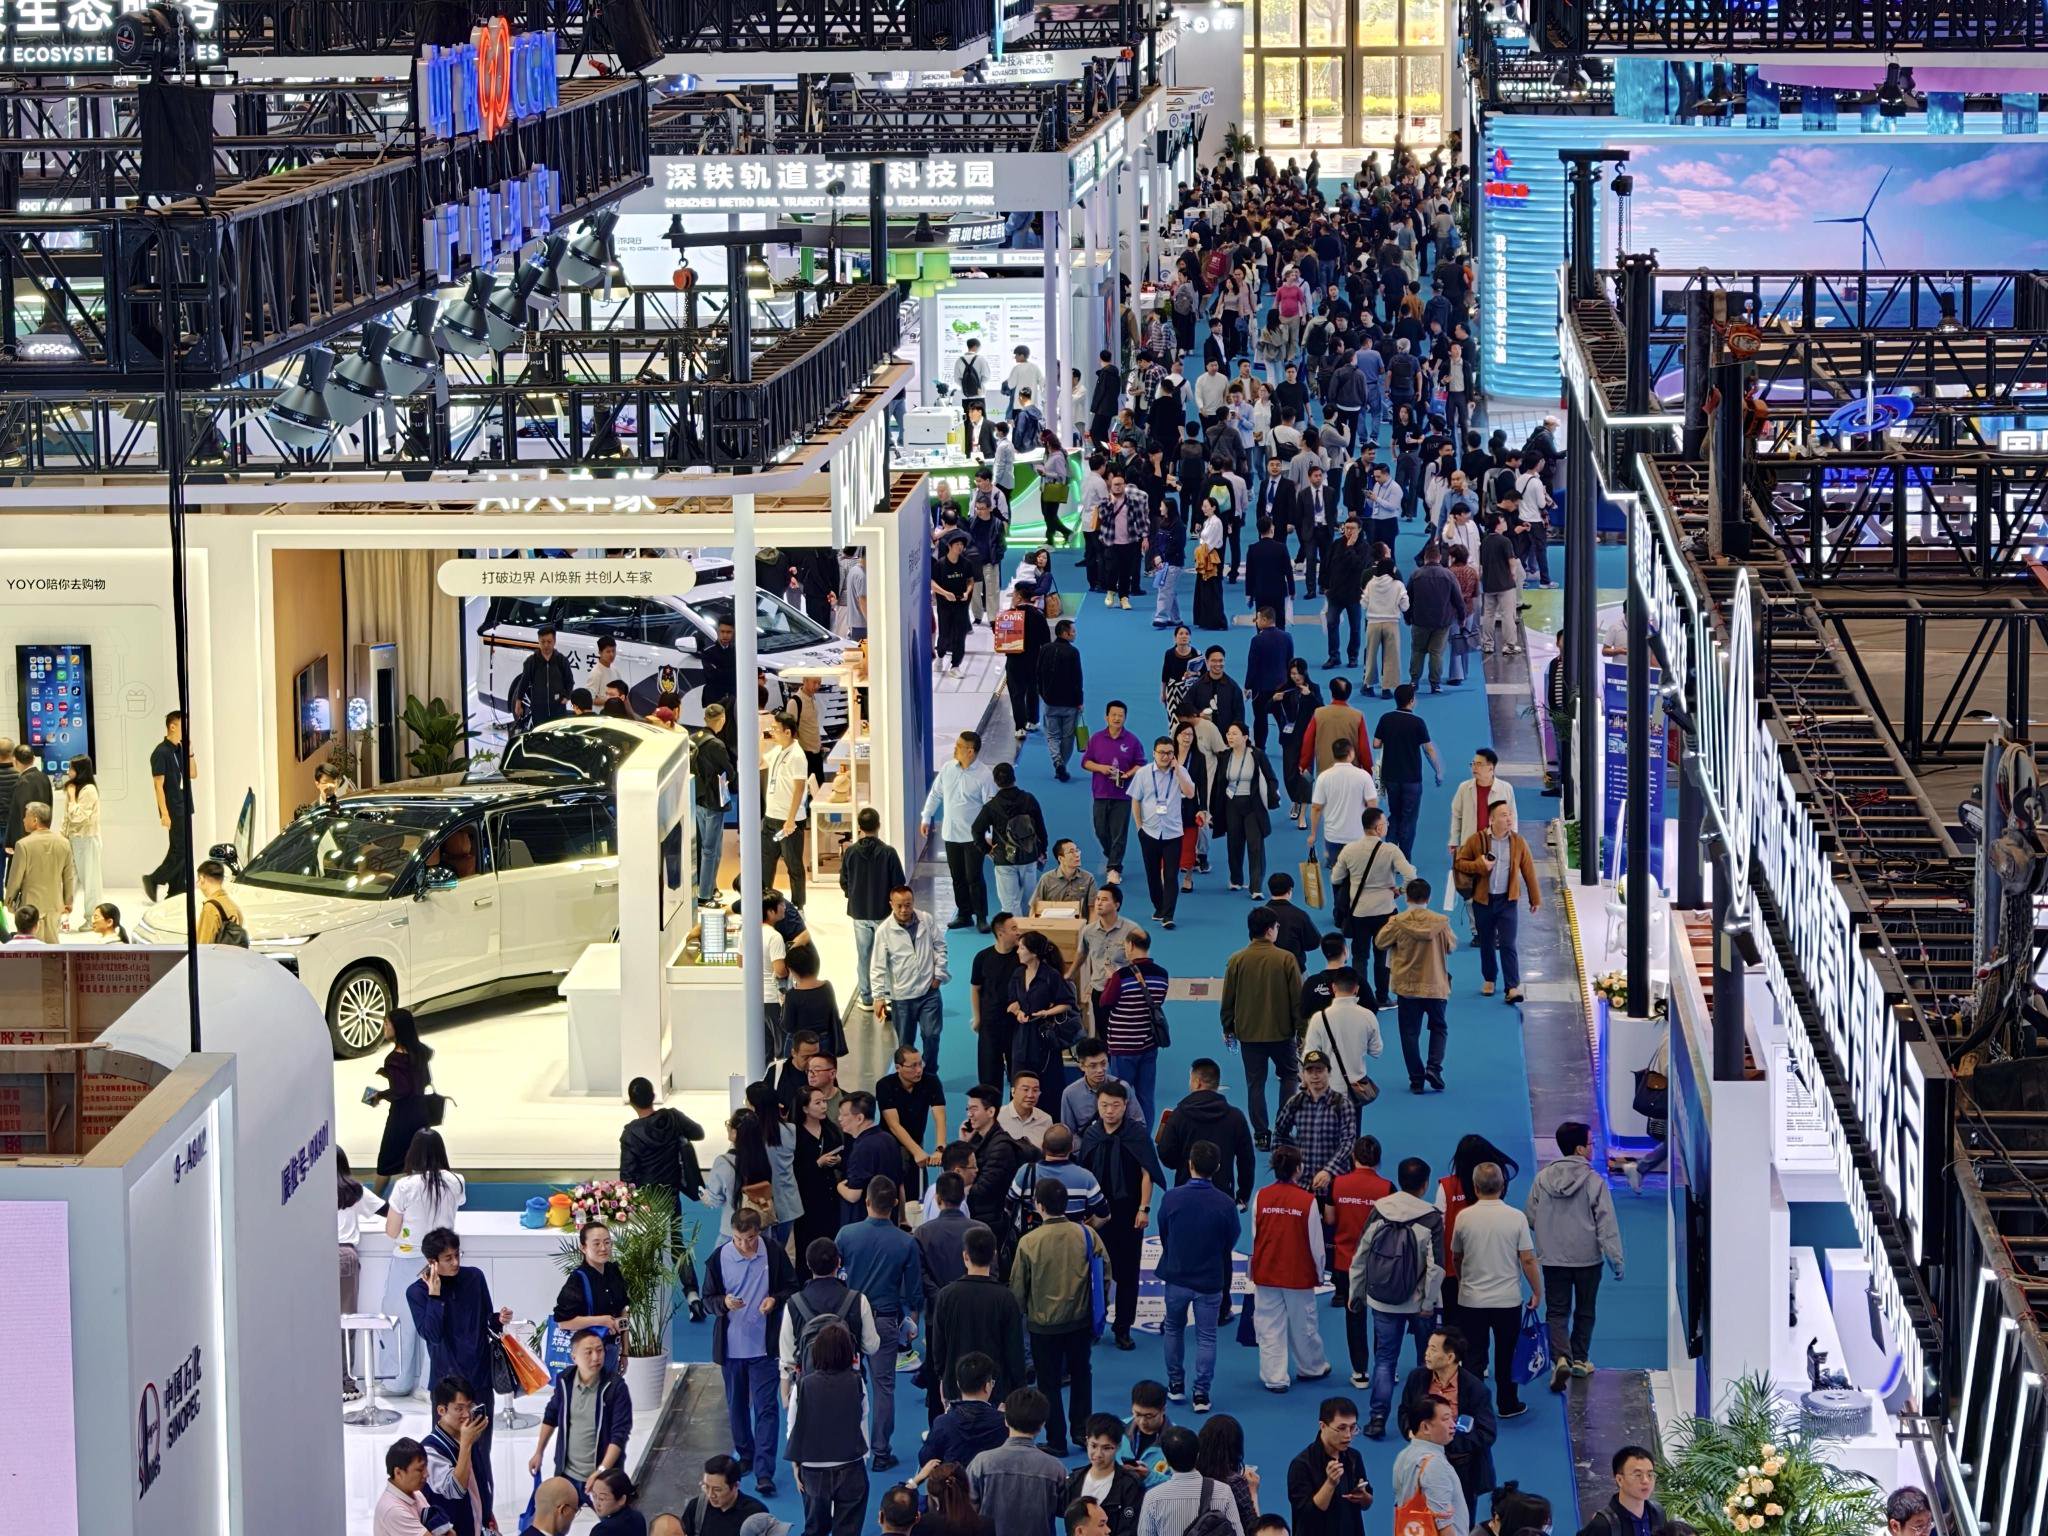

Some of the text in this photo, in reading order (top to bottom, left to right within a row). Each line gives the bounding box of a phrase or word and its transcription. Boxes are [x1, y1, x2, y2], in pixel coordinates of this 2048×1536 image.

[665, 197, 717, 208] SHENZHEN
[718, 197, 755, 208] METRO
[756, 197, 780, 207] RAIL
[782, 196, 825, 207] TRANSIT
[896, 195, 962, 206] TECHNOLOGY
[965, 195, 995, 206] PARK
[839, 408, 887, 550] HONOR
[6, 578, 107, 591] YOYO陪你去购物
[482, 571, 653, 585] 打破边界 AI焕新 共创人车家
[164, 1344, 202, 1418] 中国石化
[167, 1388, 201, 1450] SINOPEC
